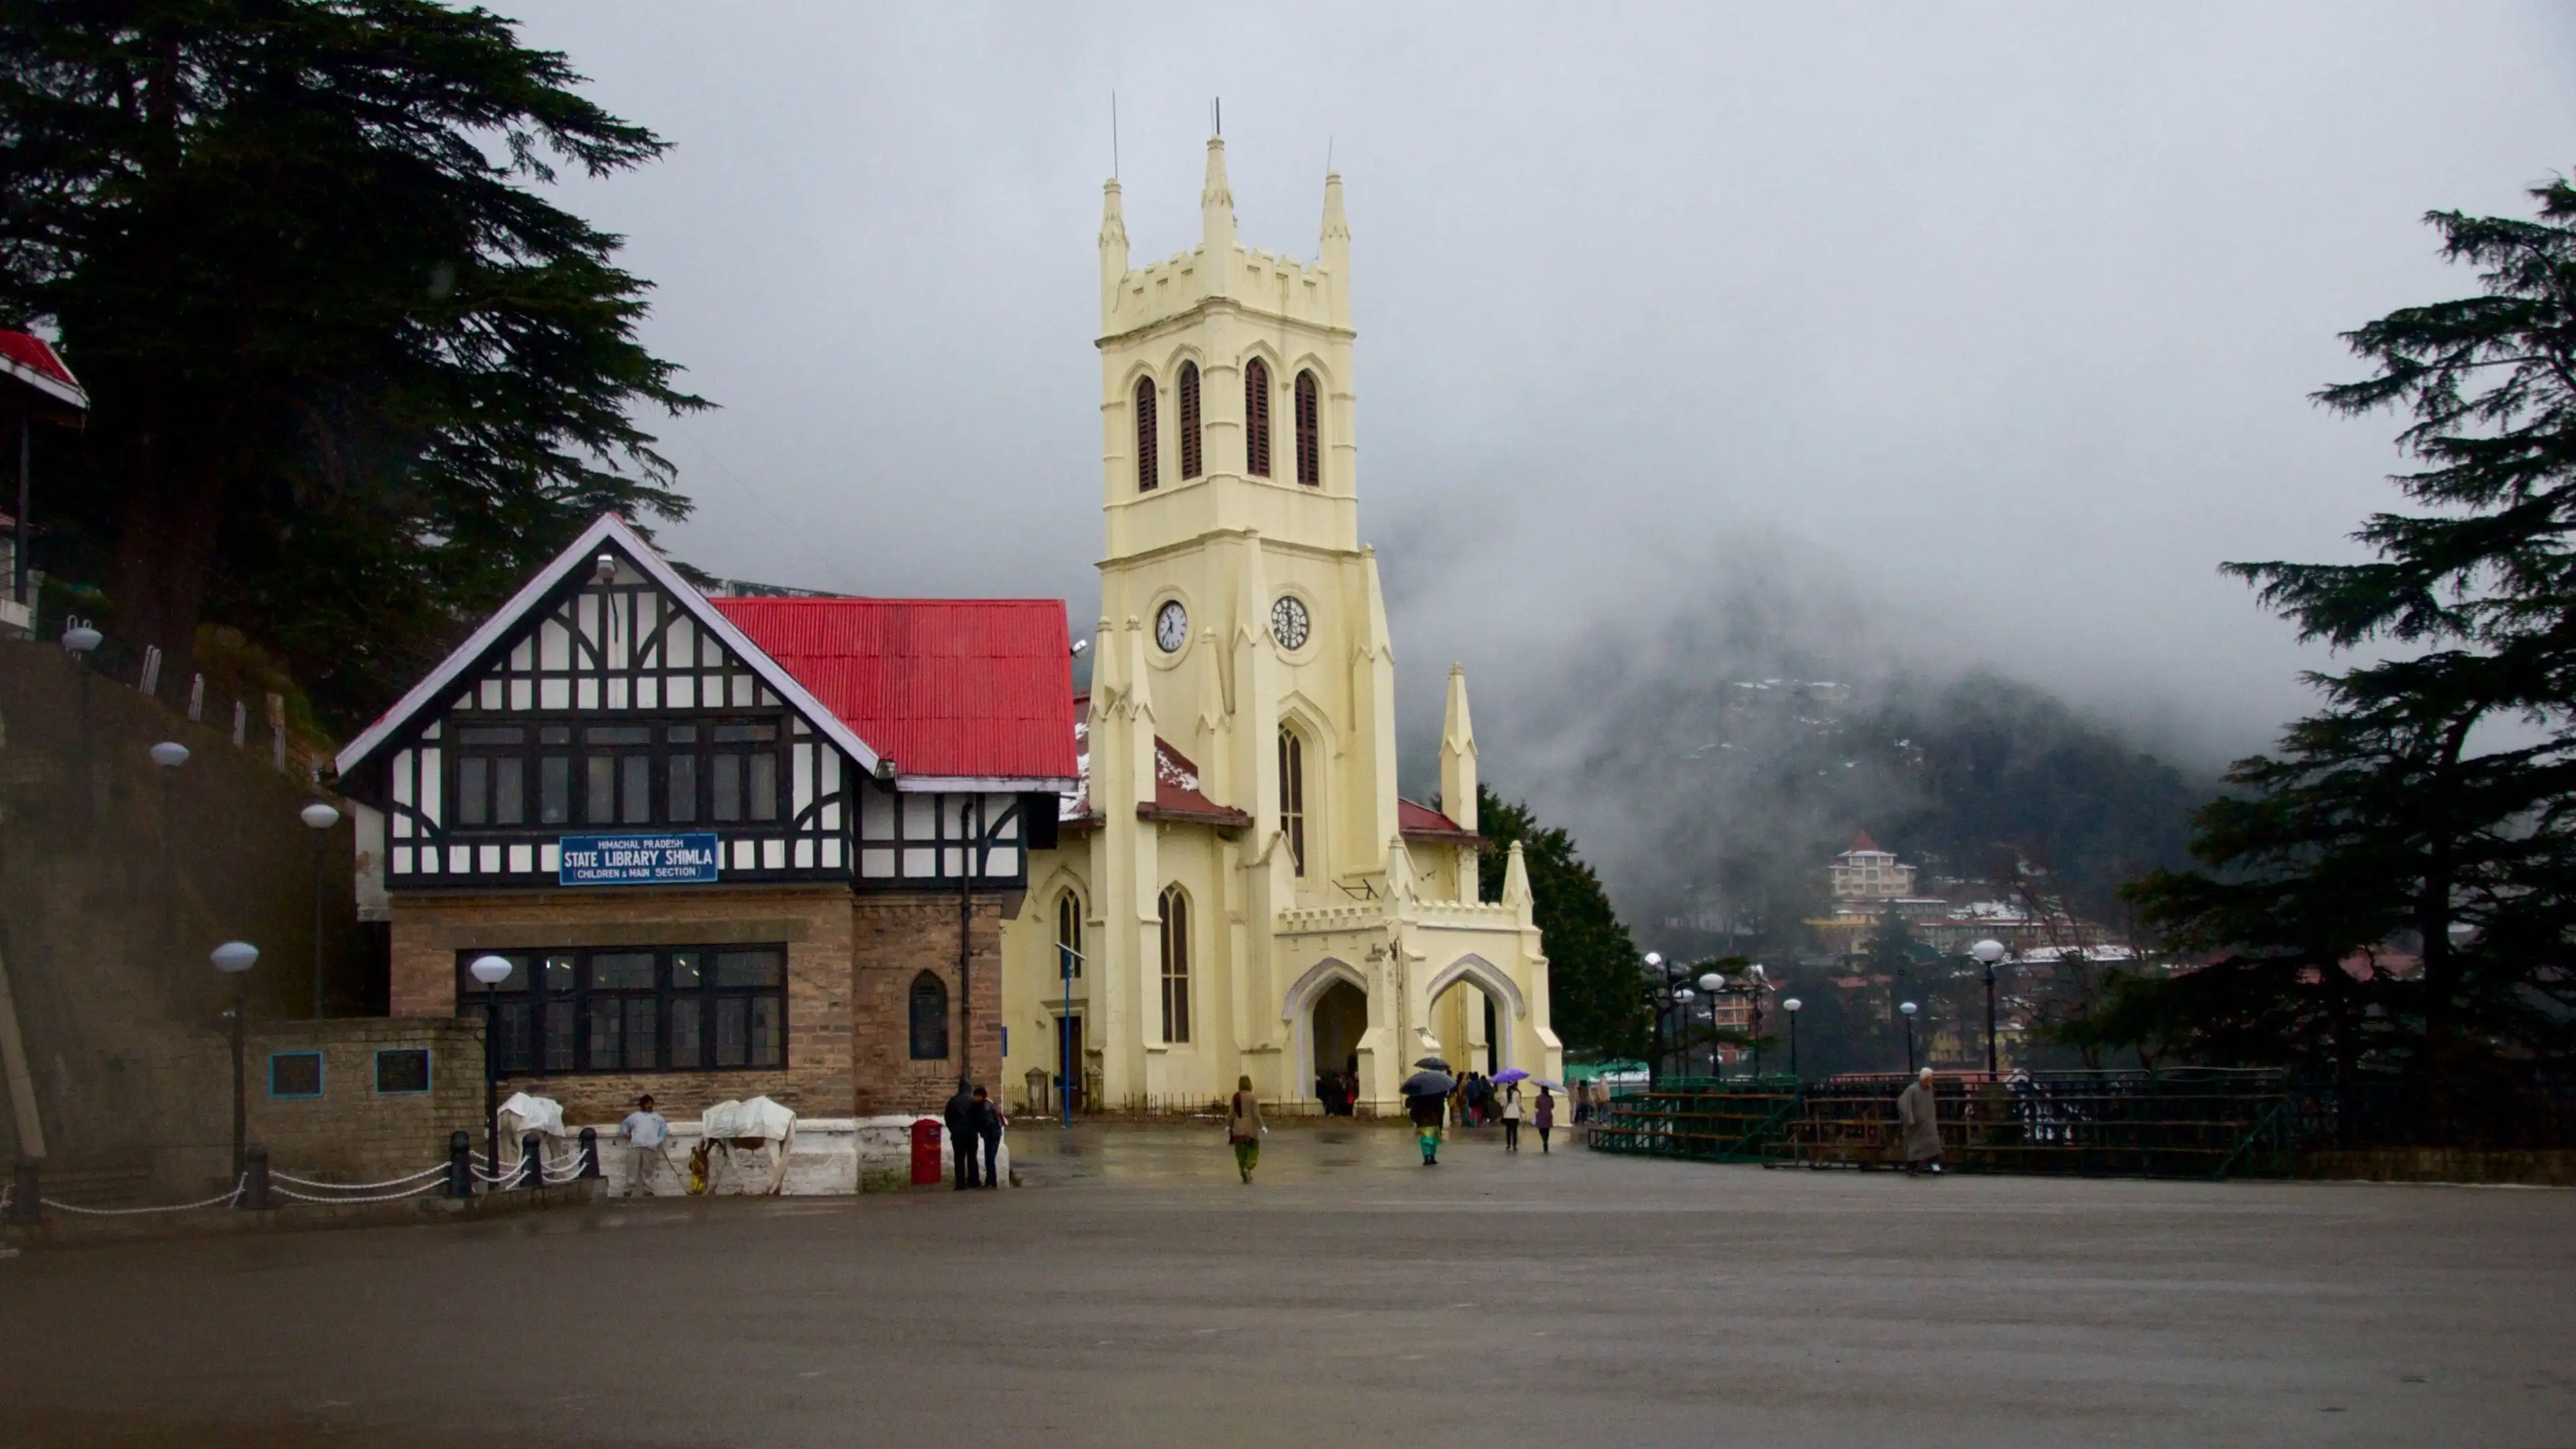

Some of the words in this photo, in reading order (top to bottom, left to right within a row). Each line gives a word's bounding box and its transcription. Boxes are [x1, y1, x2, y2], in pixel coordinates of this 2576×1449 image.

[598, 840, 640, 849] HIMACHAL
[644, 839, 684, 849] PRADESH
[565, 851, 598, 867] STATE
[605, 850, 659, 866] LIBRARY
[665, 849, 712, 865] SHIMLA
[629, 868, 649, 877] MAIN
